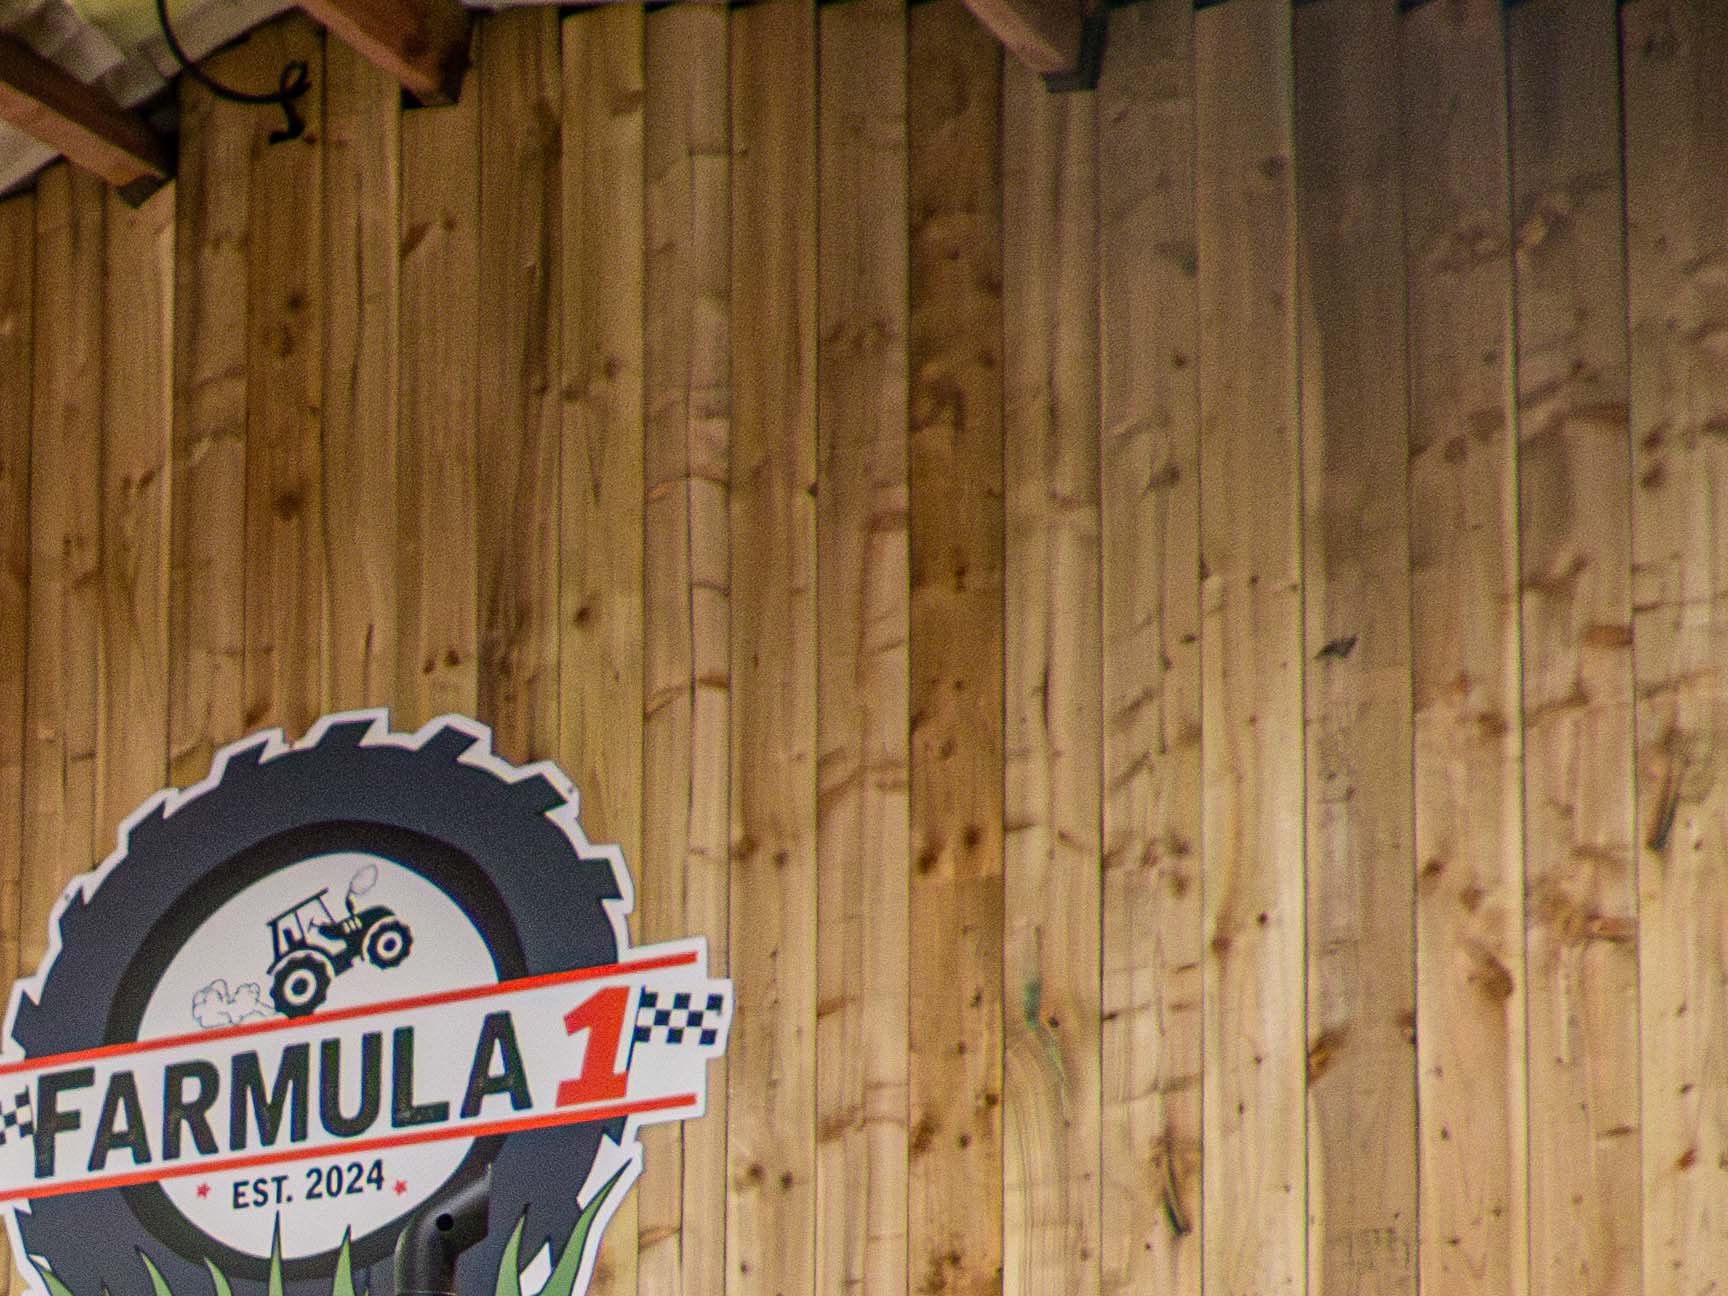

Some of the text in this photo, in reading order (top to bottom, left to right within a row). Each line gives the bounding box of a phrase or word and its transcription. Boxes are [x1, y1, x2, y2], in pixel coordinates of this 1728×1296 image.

[32, 986, 631, 1178] FARMULA 1
[231, 1159, 385, 1211] EST. 2024
